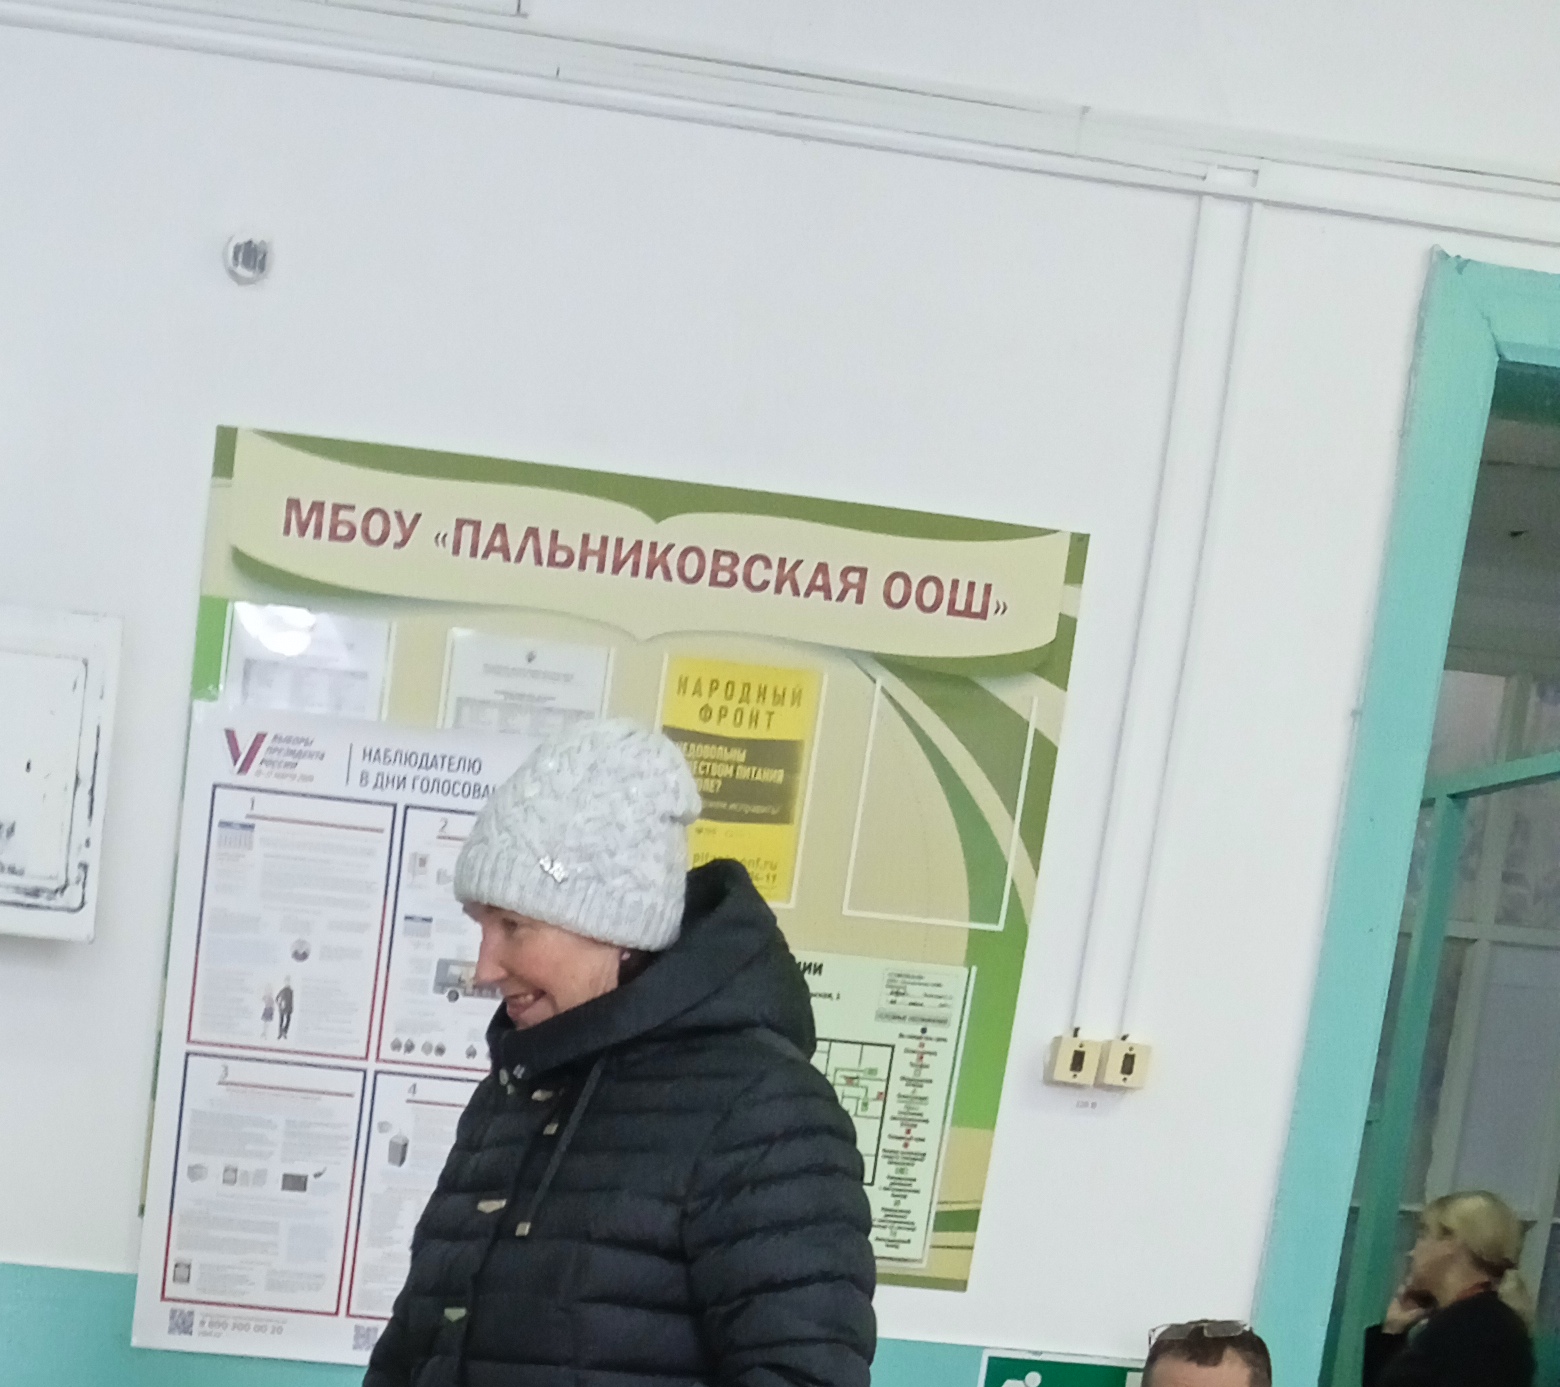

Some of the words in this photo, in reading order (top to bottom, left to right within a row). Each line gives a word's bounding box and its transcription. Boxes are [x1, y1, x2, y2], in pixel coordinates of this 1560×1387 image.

[282, 497, 422, 549] МБОУ
[434, 518, 868, 605] «ПАЛЬНИКОВСКАЯ
[882, 570, 1008, 621] ООШ»
[677, 674, 804, 708] НАРОДНЫЙ
[699, 703, 776, 731] ФРОНТ
[362, 746, 483, 776] НАБЛЮДАТЕЛЮ
[688, 759, 734, 778] ЕСТВОМ
[359, 769, 370, 787] В
[372, 771, 407, 792] ДНИ
[411, 774, 496, 800] ГОЛОСОВА
[440, 817, 449, 834] 2
[220, 1064, 229, 1081] 3
[407, 1083, 417, 1096] 4
